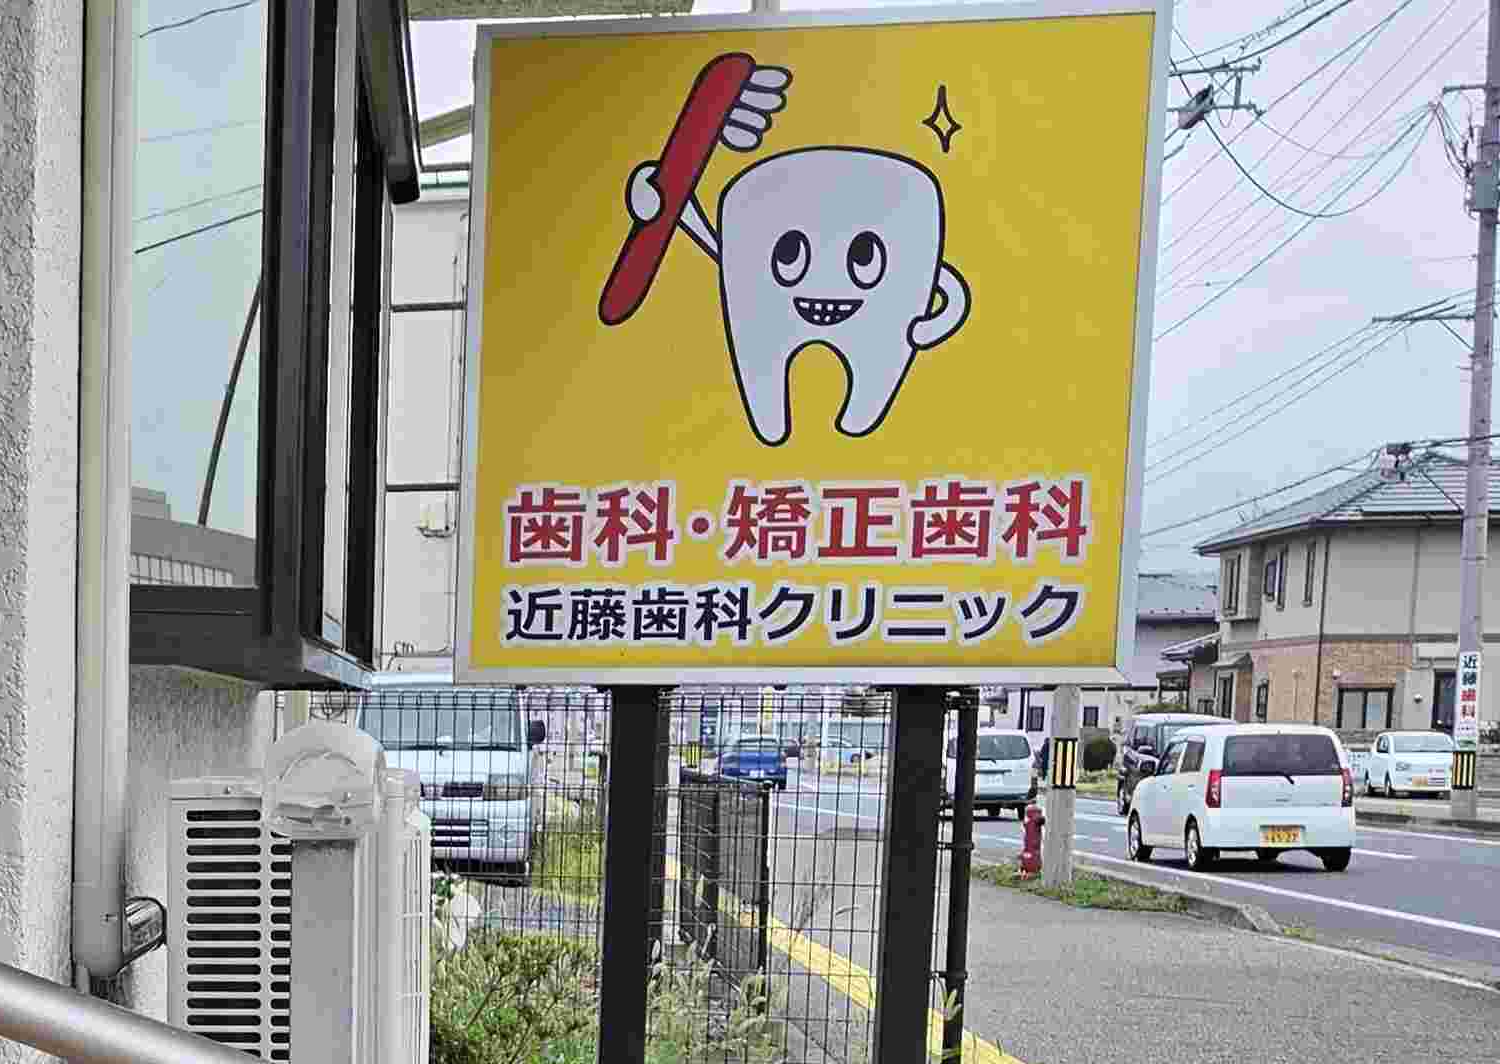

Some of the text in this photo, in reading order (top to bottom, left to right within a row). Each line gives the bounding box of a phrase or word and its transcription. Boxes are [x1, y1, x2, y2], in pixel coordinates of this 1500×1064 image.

[506, 480, 1088, 563] 歯科・矯正歯科
[504, 584, 1080, 642] 近藤歯科クリニック
